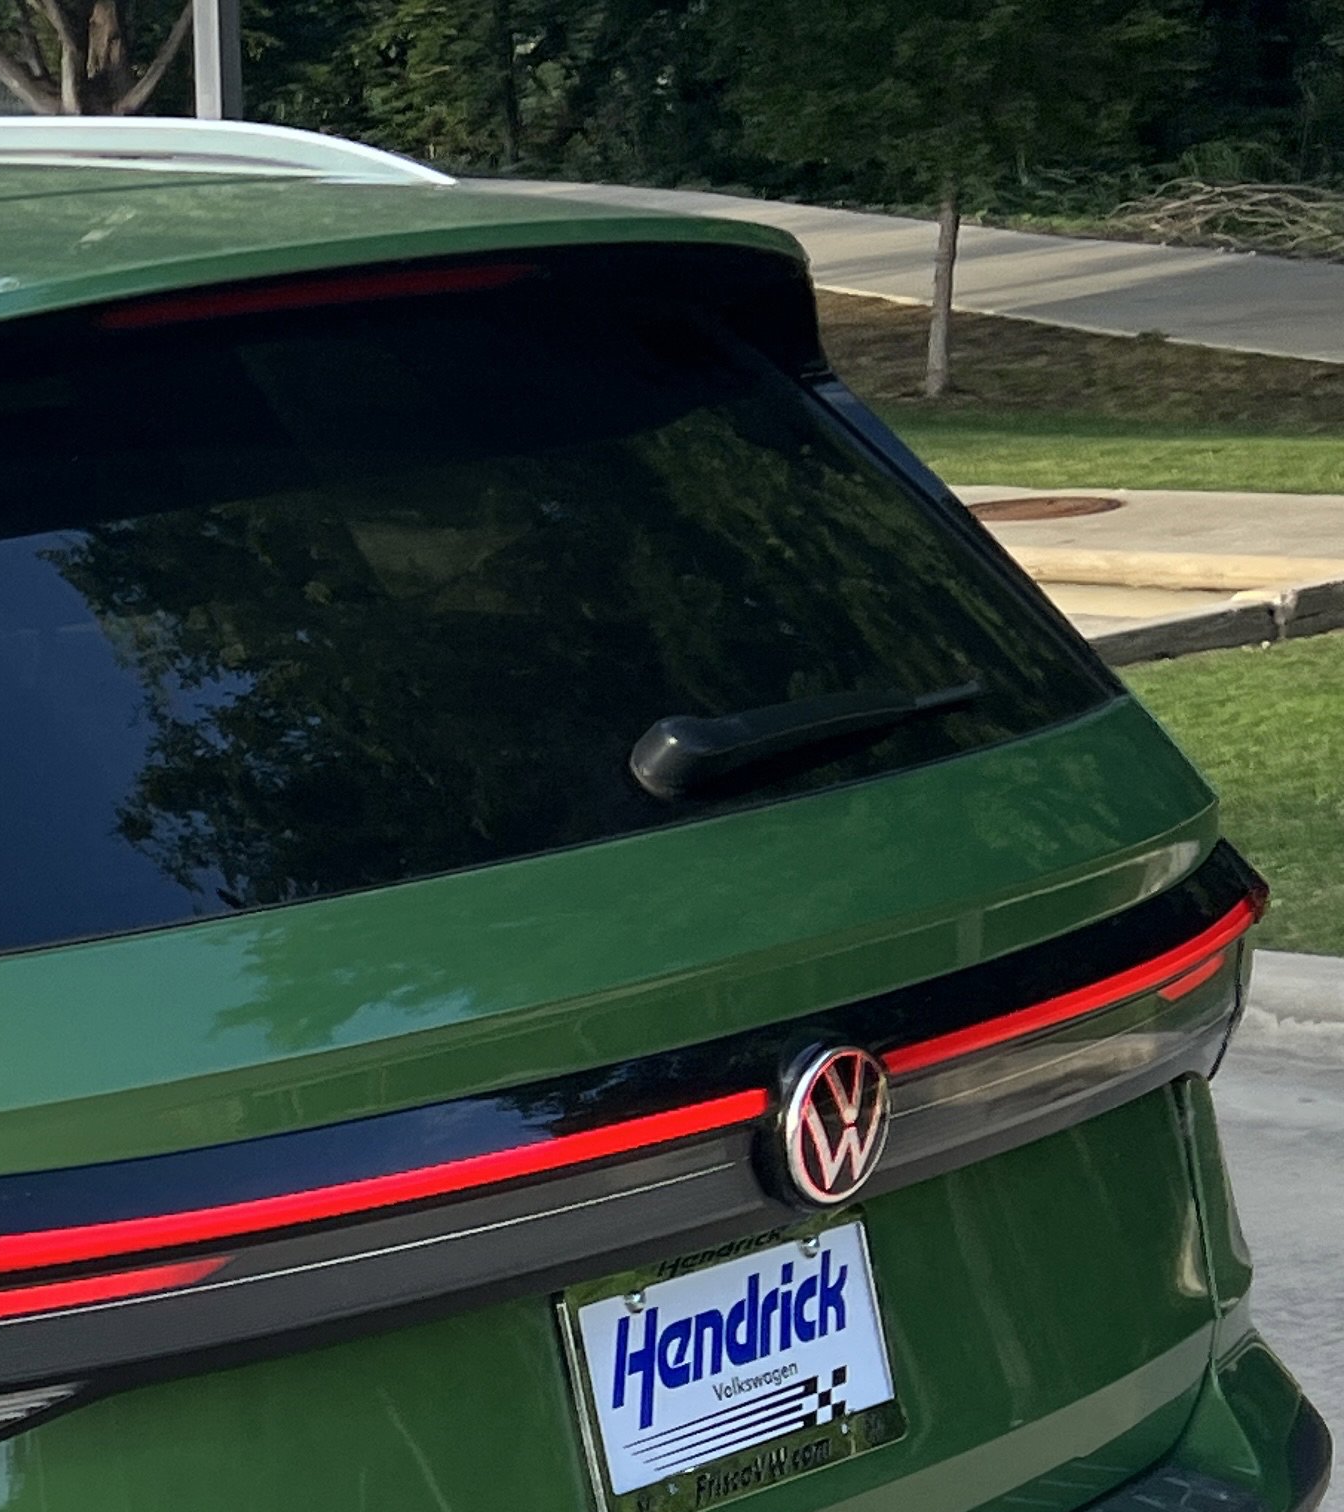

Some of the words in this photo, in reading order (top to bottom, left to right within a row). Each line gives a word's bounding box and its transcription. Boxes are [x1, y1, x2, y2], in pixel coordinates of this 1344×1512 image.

[656, 1227, 782, 1279] Hendrick
[612, 1249, 848, 1430] Hendrick
[712, 1361, 798, 1402] Volkswagen
